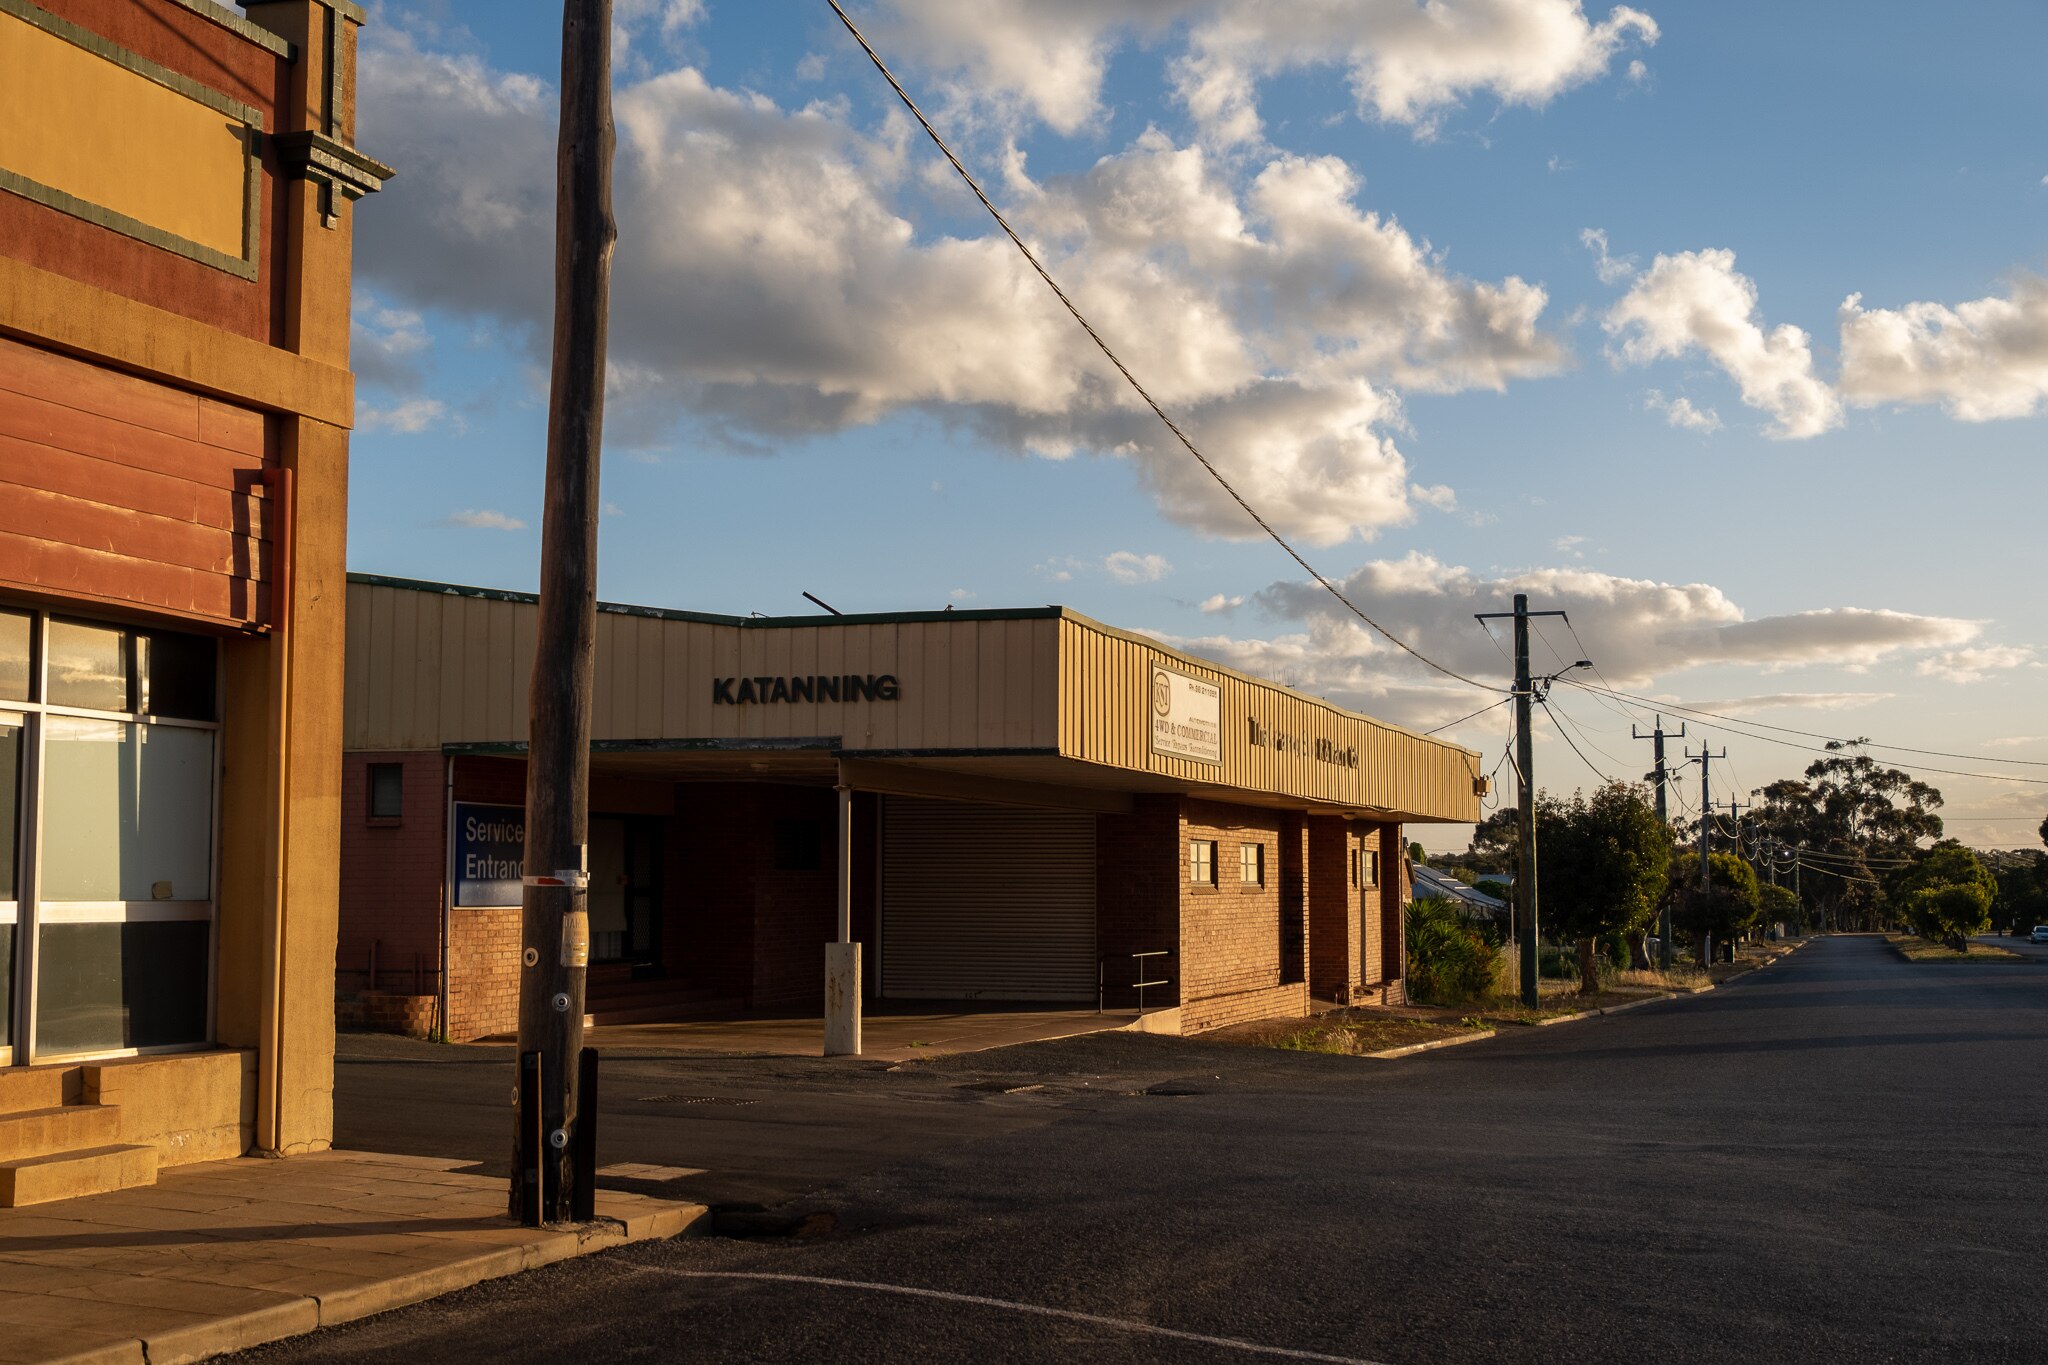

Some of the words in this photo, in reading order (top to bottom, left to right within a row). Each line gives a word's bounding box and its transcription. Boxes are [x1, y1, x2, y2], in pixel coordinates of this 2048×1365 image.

[713, 674, 901, 705] KATANNING
[1155, 719, 1169, 733] 4WD
[1171, 722, 1176, 735] &
[1177, 724, 1217, 744] COMMERCIAL
[466, 816, 524, 843] Service
[466, 853, 524, 880] Entranc
